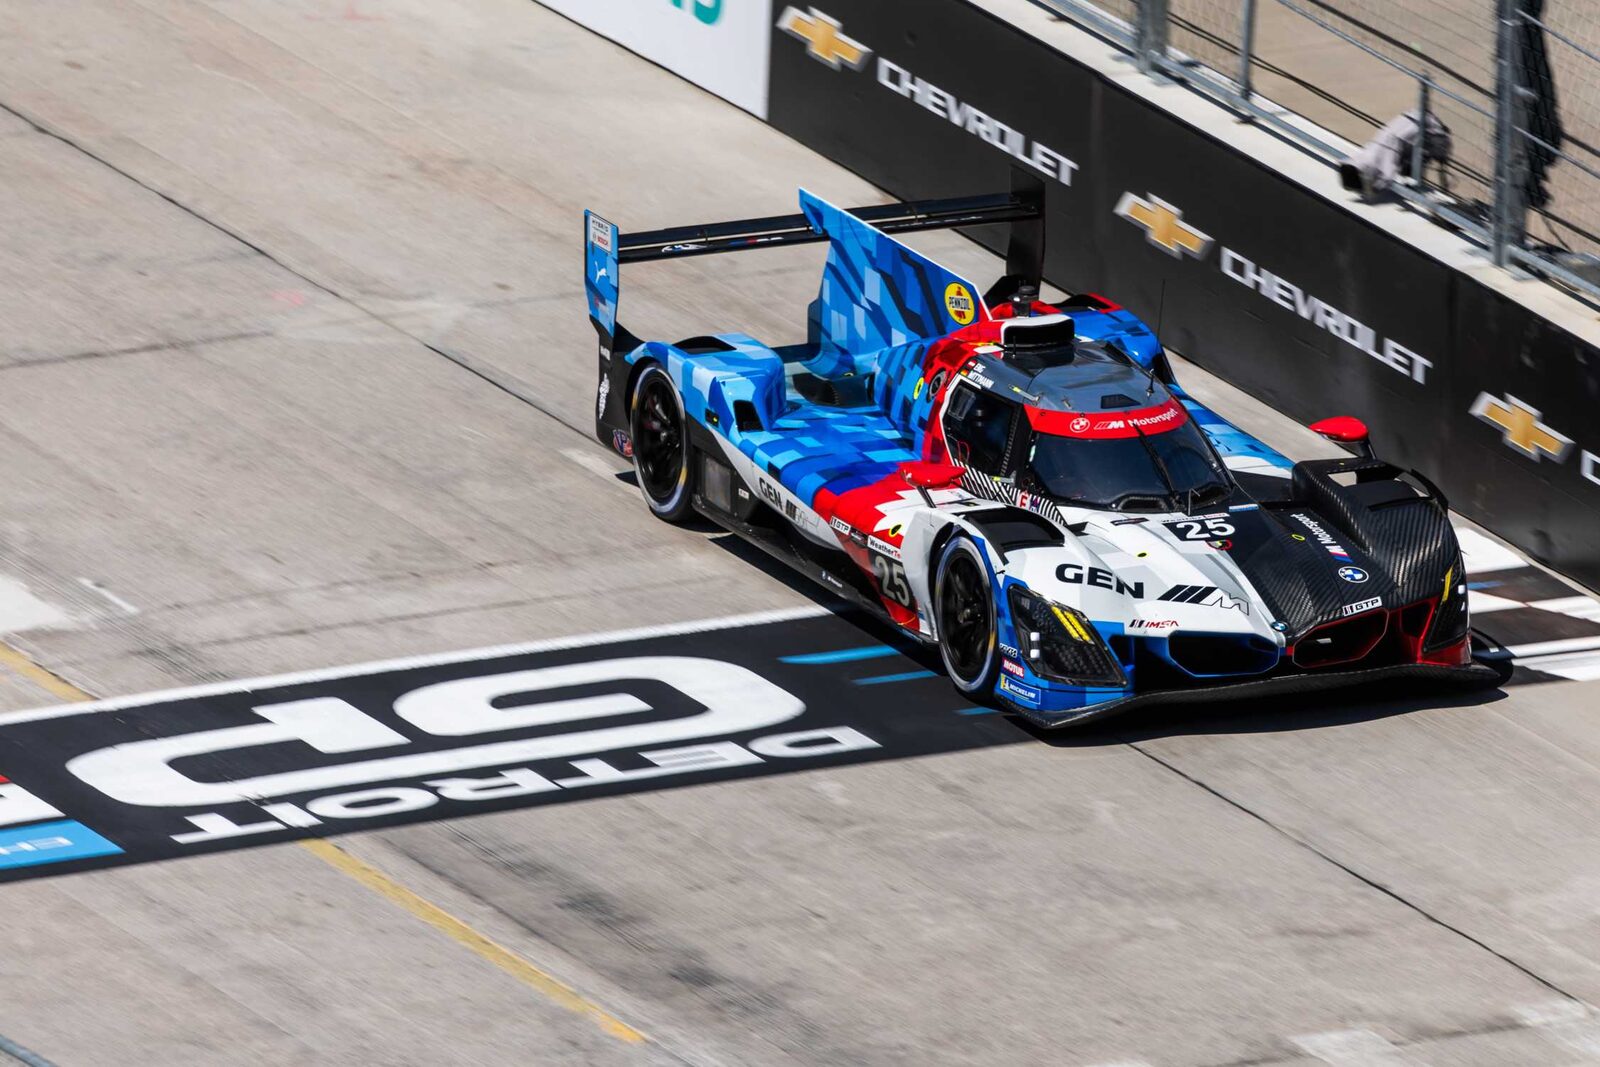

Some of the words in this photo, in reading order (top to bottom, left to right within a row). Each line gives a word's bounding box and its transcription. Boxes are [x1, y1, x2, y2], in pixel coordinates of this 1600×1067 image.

[877, 57, 1080, 187] CHEVROLET
[948, 296, 971, 311] PENNZOIL
[1220, 246, 1434, 385] CHEVROLET
[1128, 407, 1179, 427] Motorsport
[759, 477, 784, 511] GEN
[1176, 518, 1236, 539] 25
[1290, 513, 1337, 544] Motorsport
[875, 554, 910, 607] 25
[1055, 563, 1144, 599] GEN
[1355, 598, 1379, 611] GTP
[1145, 619, 1179, 629] IMSA
[1004, 659, 1024, 677] MOTUL
[1010, 683, 1036, 698] MICHELIN
[170, 725, 883, 845] DETROIT
